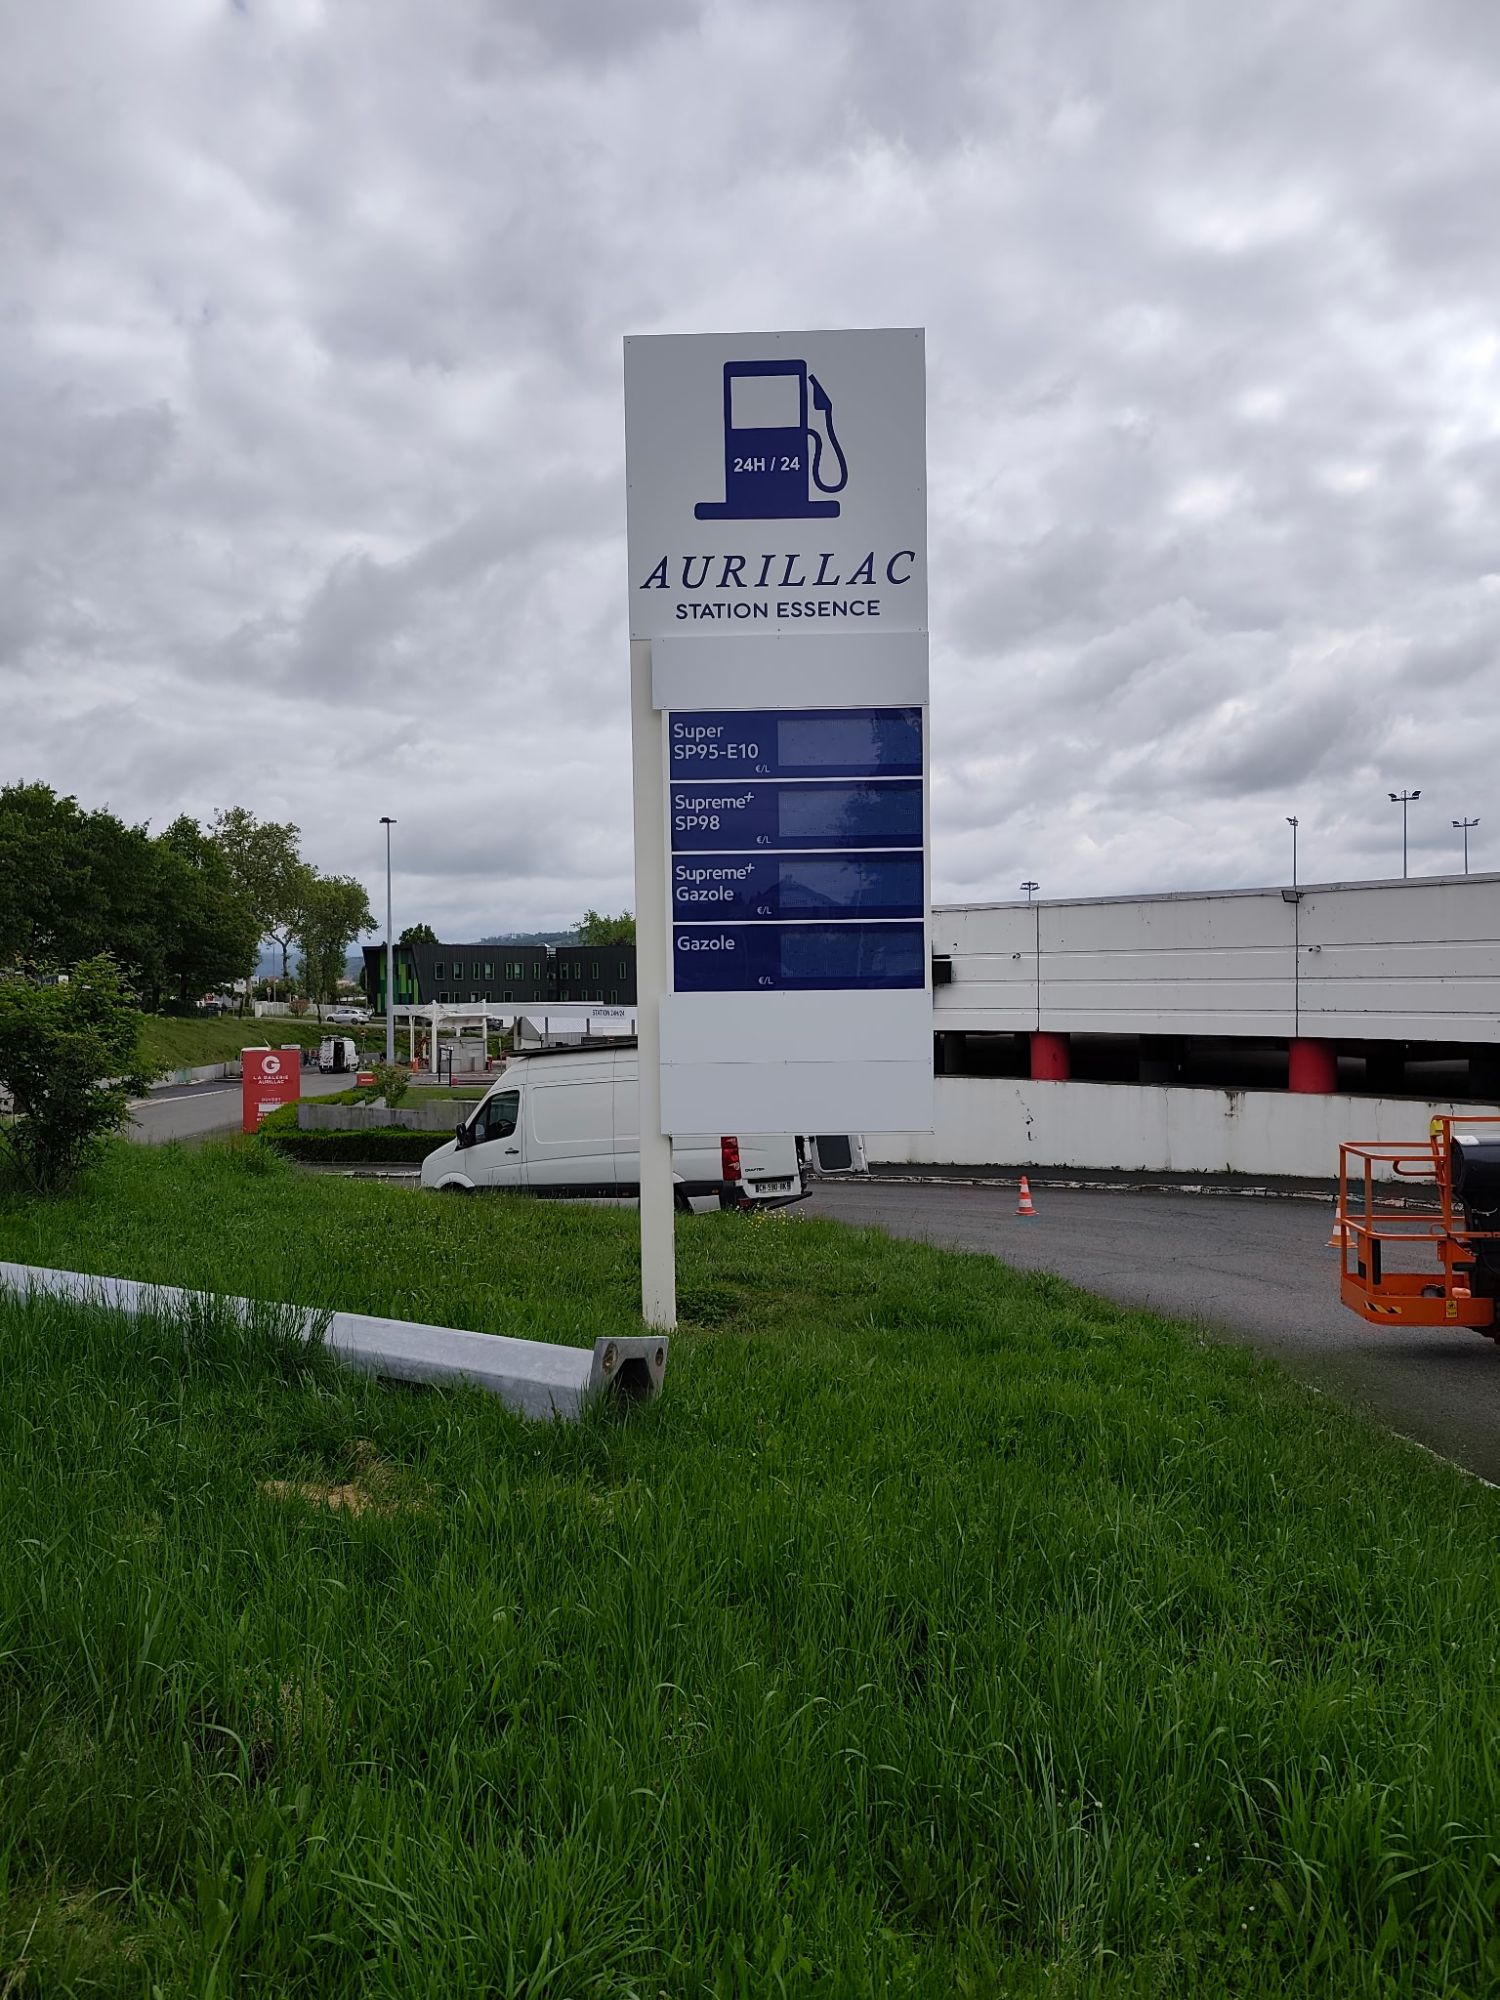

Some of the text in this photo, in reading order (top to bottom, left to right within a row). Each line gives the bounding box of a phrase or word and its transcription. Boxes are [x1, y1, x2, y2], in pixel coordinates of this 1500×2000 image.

[733, 456, 800, 472] 24H / 24
[640, 550, 916, 589] AURILLAC
[675, 600, 880, 619] STATION ESSENCE
[673, 723, 723, 742] Super
[674, 743, 759, 759] SP95-E10
[755, 764, 770, 774] €/L
[675, 816, 720, 831] SP98
[756, 835, 771, 845] €/L
[676, 886, 734, 901] Gazole
[757, 906, 772, 916] €/L
[677, 935, 735, 951] Gazole
[758, 976, 773, 986] €/L
[592, 1009, 610, 1017] STATION
